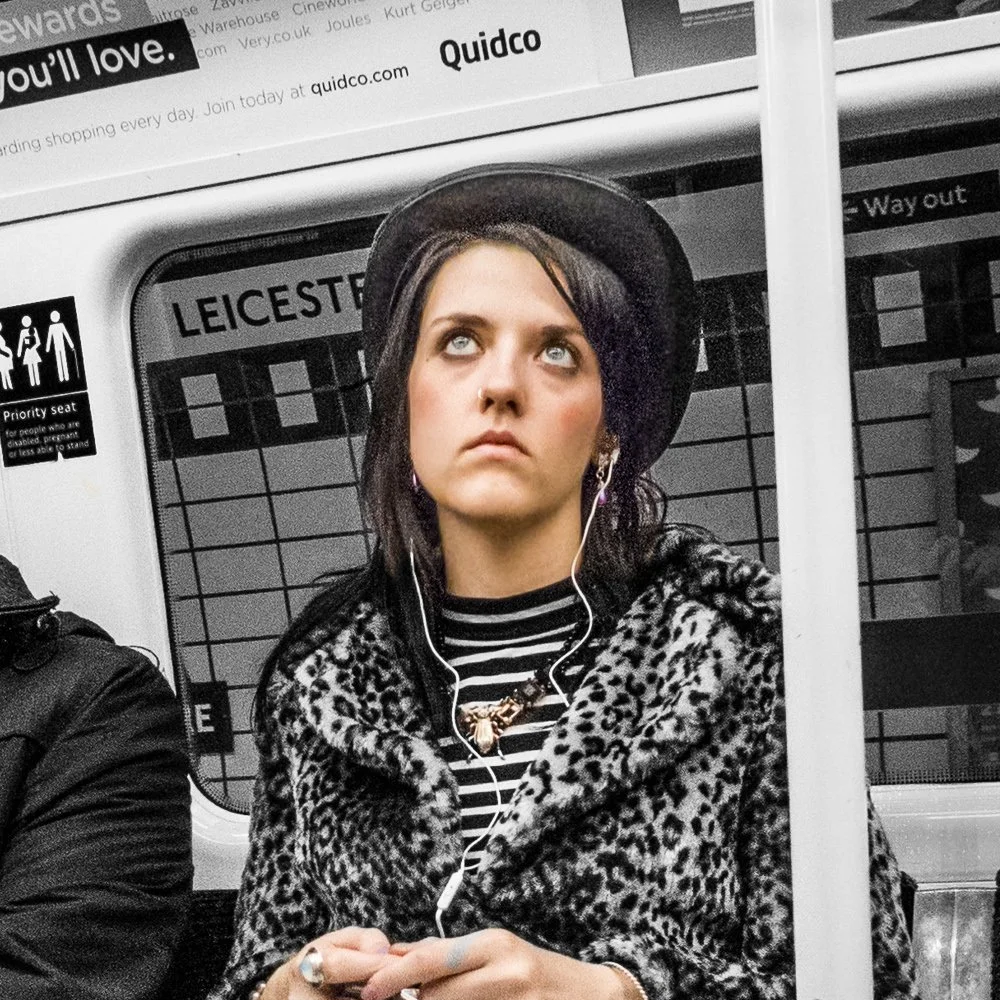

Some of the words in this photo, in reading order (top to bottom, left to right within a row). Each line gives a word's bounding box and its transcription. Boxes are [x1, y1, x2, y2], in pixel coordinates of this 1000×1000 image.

[200, 9, 280, 35] Warehouse
[238, 25, 311, 50] Very.co.uk
[325, 13, 371, 33] Joules
[384, 2, 416, 20] Kurt
[87, 38, 175, 79] love.
[439, 28, 542, 72] Quidco
[45, 119, 116, 148] shopping
[120, 112, 161, 140] every
[203, 99, 235, 117] Join
[240, 90, 284, 109] today
[290, 85, 306, 100] at
[311, 65, 409, 97] quidco.com
[863, 195, 917, 219] Way
[923, 184, 967, 210] out
[3, 406, 47, 422] Priority
[50, 402, 77, 416] seat
[5, 429, 17, 438] for
[19, 425, 46, 437] people
[48, 422, 66, 432] who
[67, 420, 80, 429] are
[43, 431, 79, 445] pregnant
[8, 450, 17, 459] or
[19, 447, 35, 458] less
[37, 444, 54, 455] able
[55, 443, 65, 452] to
[67, 439, 90, 451] stand
